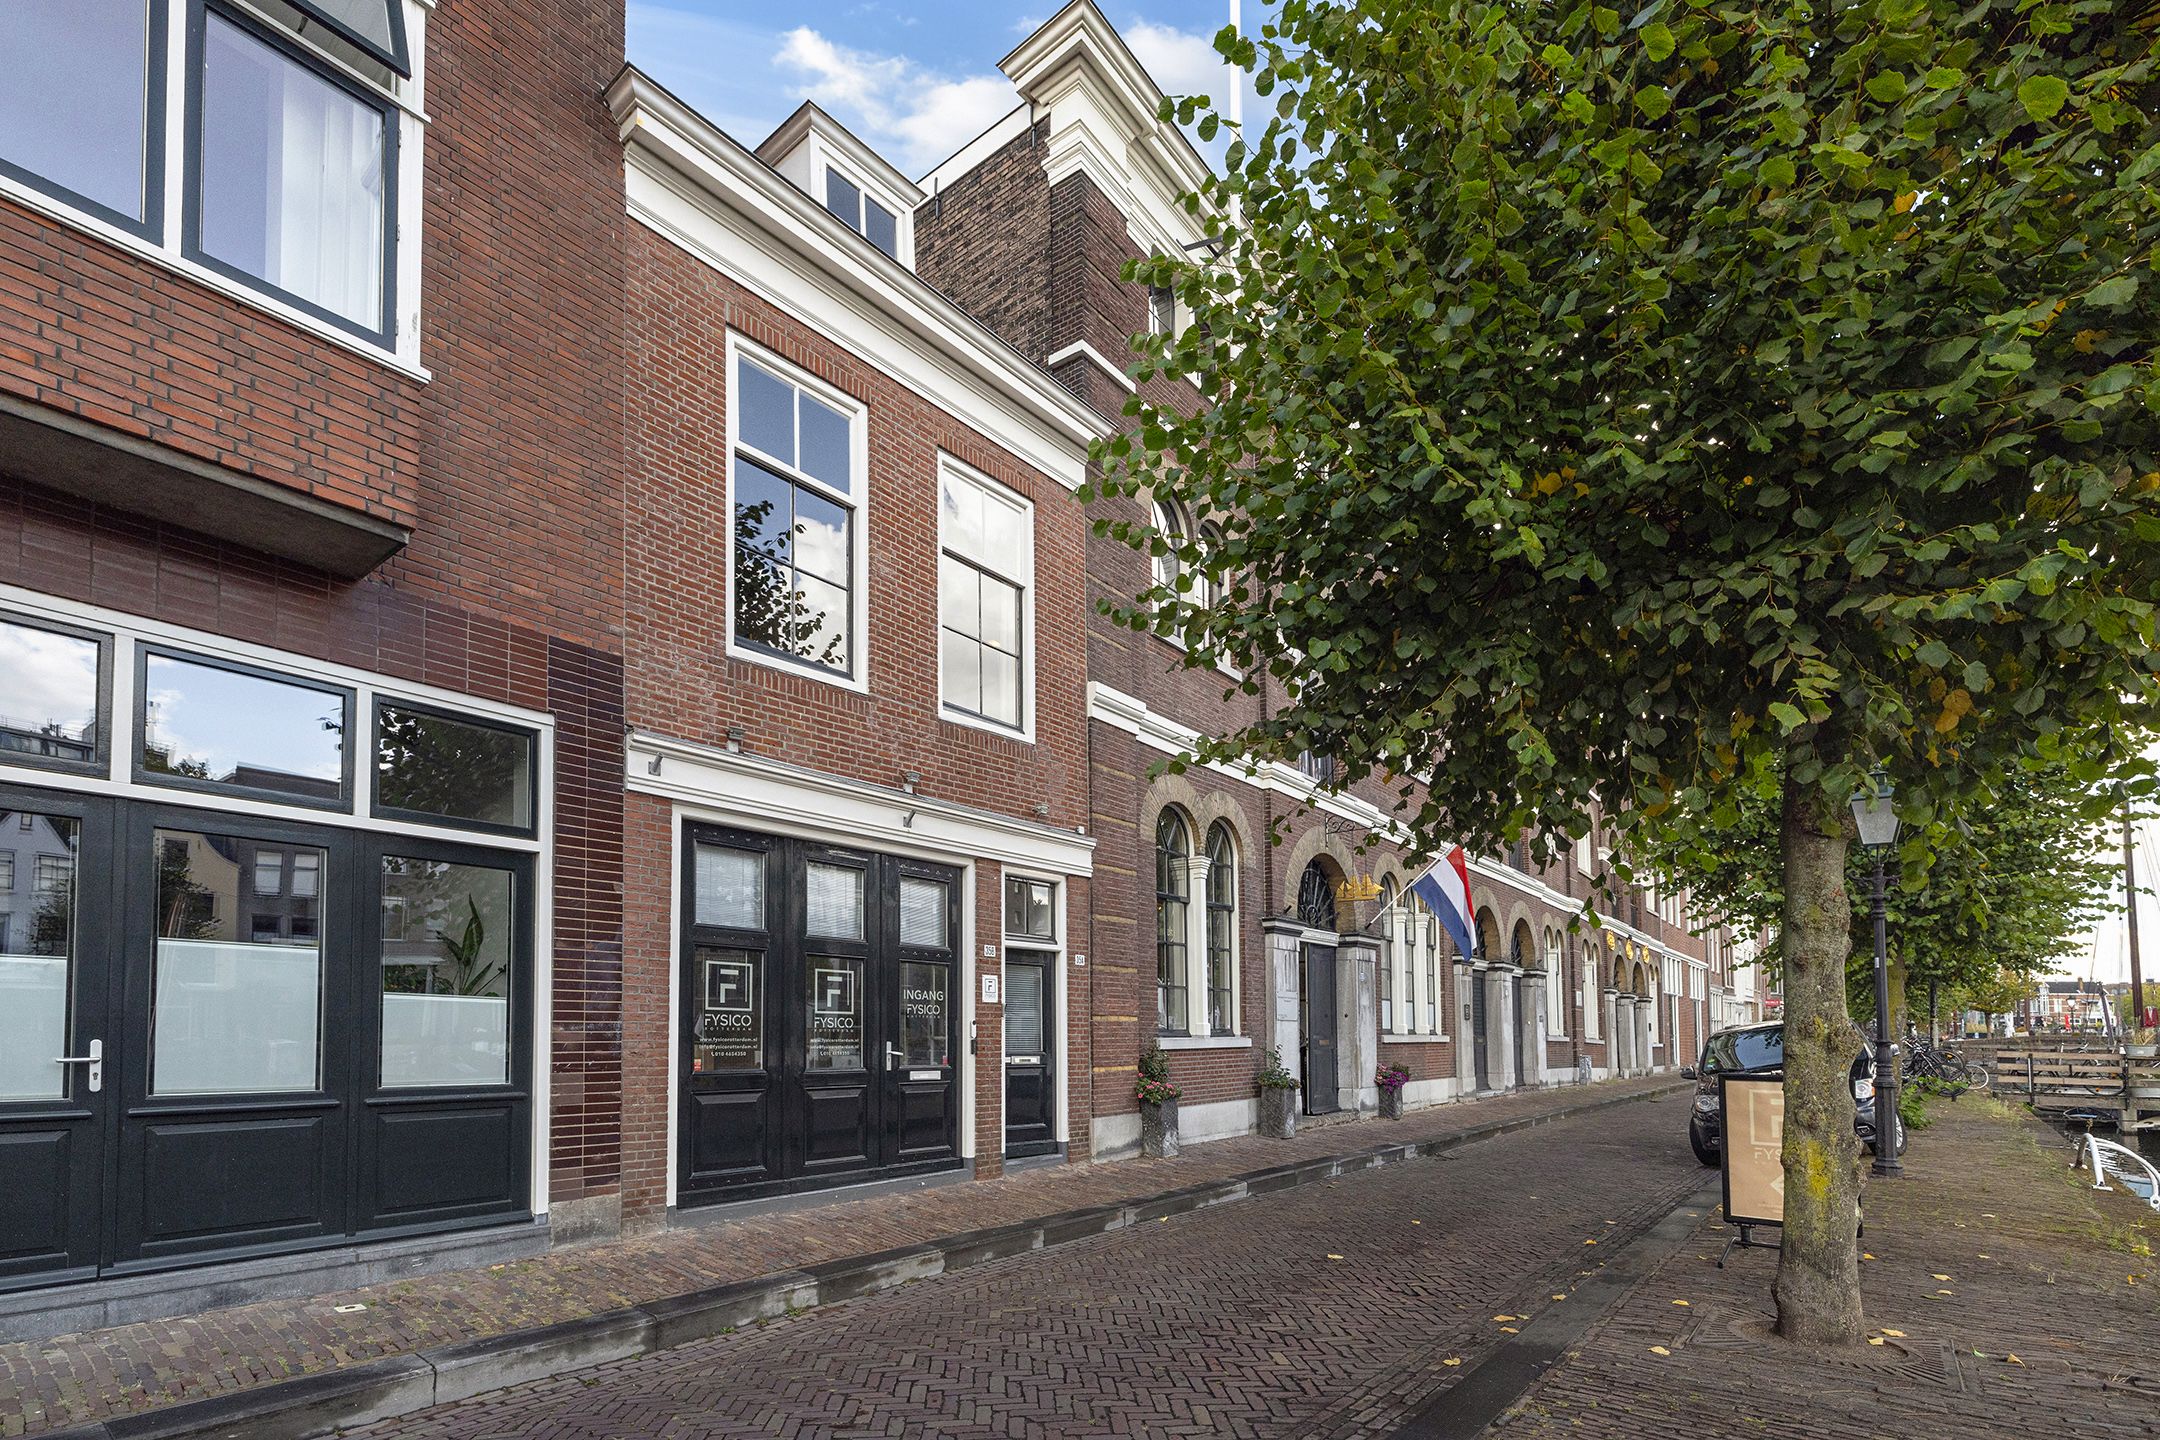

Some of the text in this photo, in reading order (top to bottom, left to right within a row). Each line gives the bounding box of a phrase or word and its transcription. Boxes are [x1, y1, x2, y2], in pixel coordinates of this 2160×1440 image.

[720, 969, 739, 1003] F
[827, 976, 843, 1007] F
[903, 989, 944, 1001] INGANG
[906, 1004, 940, 1015] FYSICO
[705, 1013, 752, 1026] FYSICO
[814, 1017, 854, 1029] FYSICO
